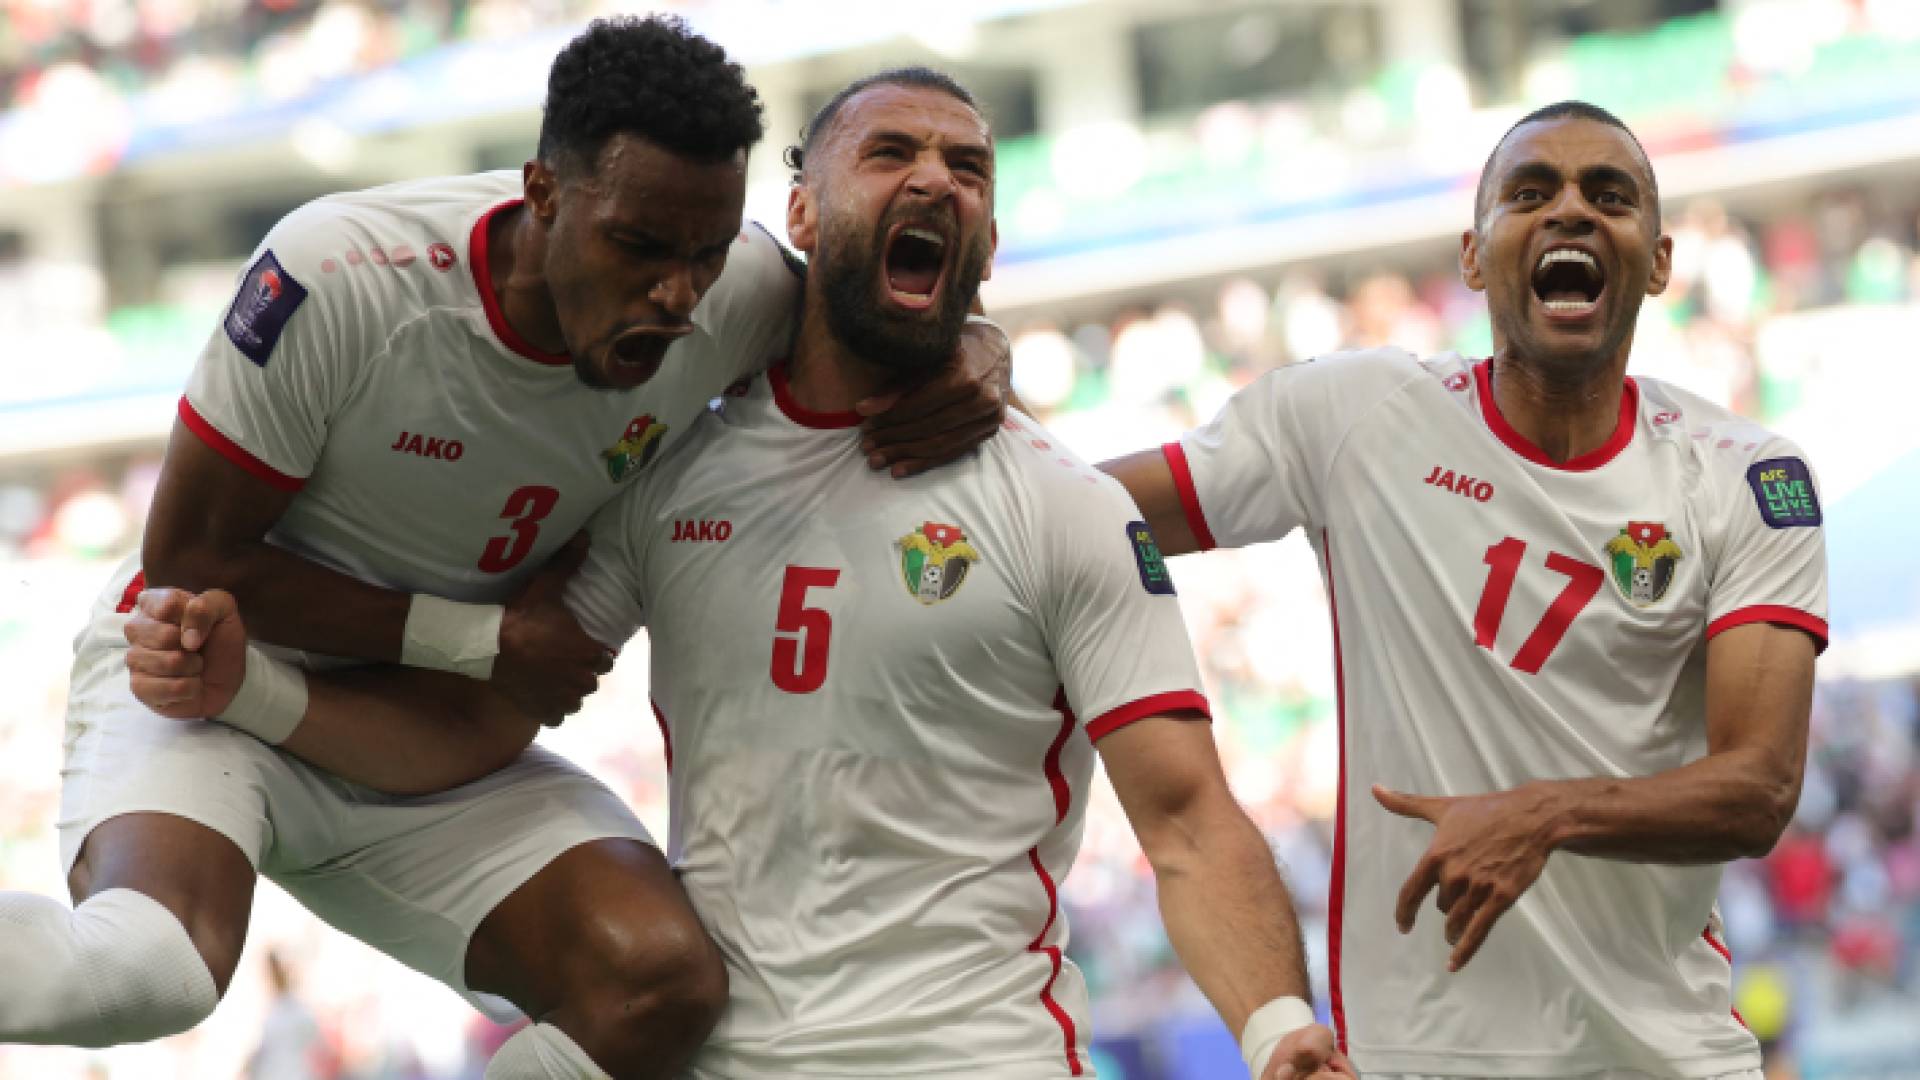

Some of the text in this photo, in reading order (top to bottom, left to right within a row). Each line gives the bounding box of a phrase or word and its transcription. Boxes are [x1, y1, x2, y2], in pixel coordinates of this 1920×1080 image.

[391, 431, 464, 462] JAKO
[1424, 464, 1495, 503] JAKO
[477, 485, 560, 573] 3
[671, 519, 732, 543] JAKO
[770, 564, 841, 694] 5
[1474, 535, 1605, 675] 17
